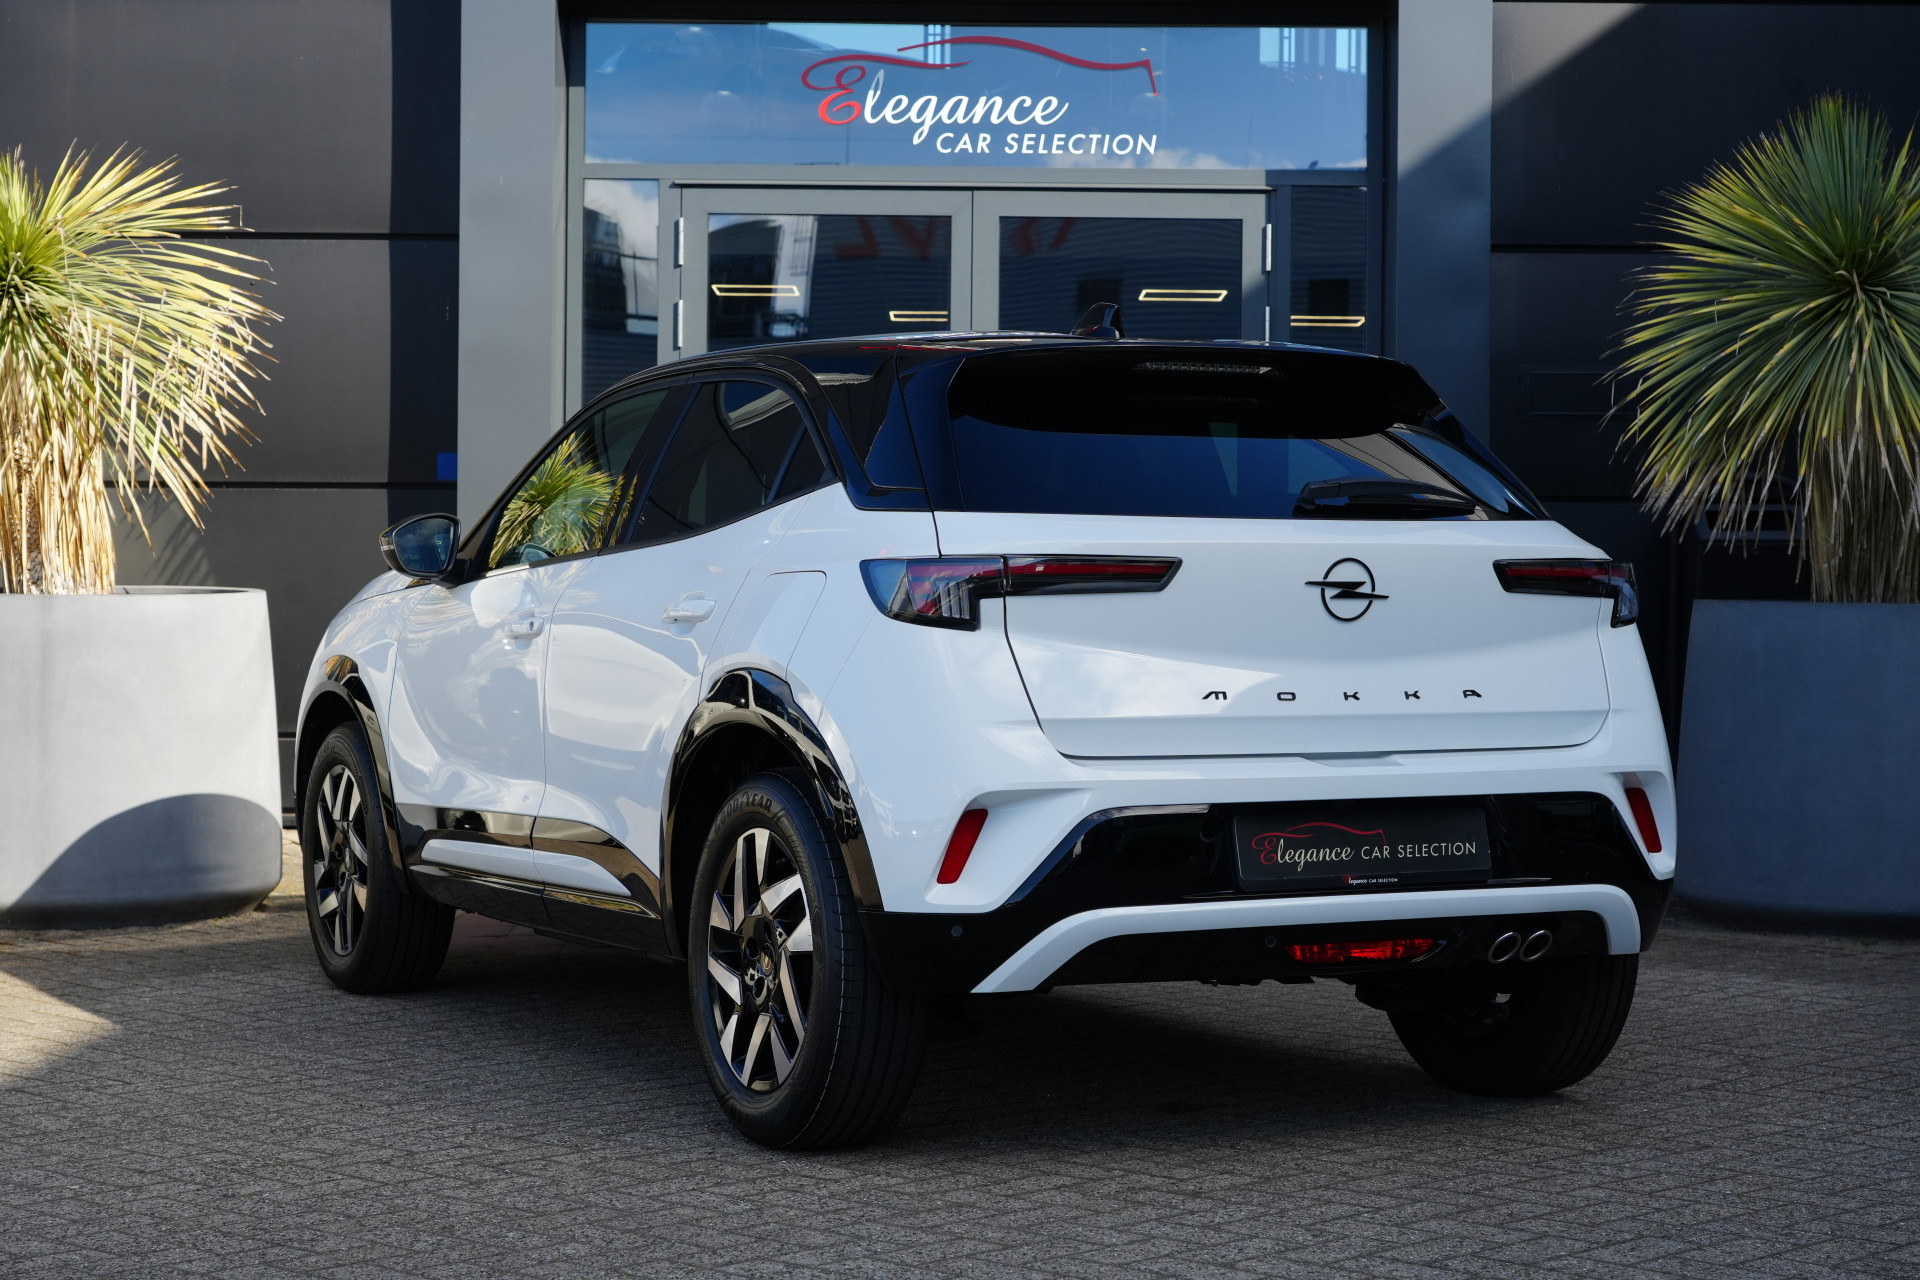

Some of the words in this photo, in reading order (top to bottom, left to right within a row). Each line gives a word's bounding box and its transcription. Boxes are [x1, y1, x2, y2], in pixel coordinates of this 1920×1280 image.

[801, 54, 1068, 145] Elegance
[936, 132, 991, 154] CAR
[1004, 133, 1157, 155] SELECTION
[1202, 689, 1482, 701] MOKKA
[1252, 833, 1355, 872] Elegance
[1361, 846, 1390, 860] CAR
[1398, 841, 1476, 858] SELECTION
